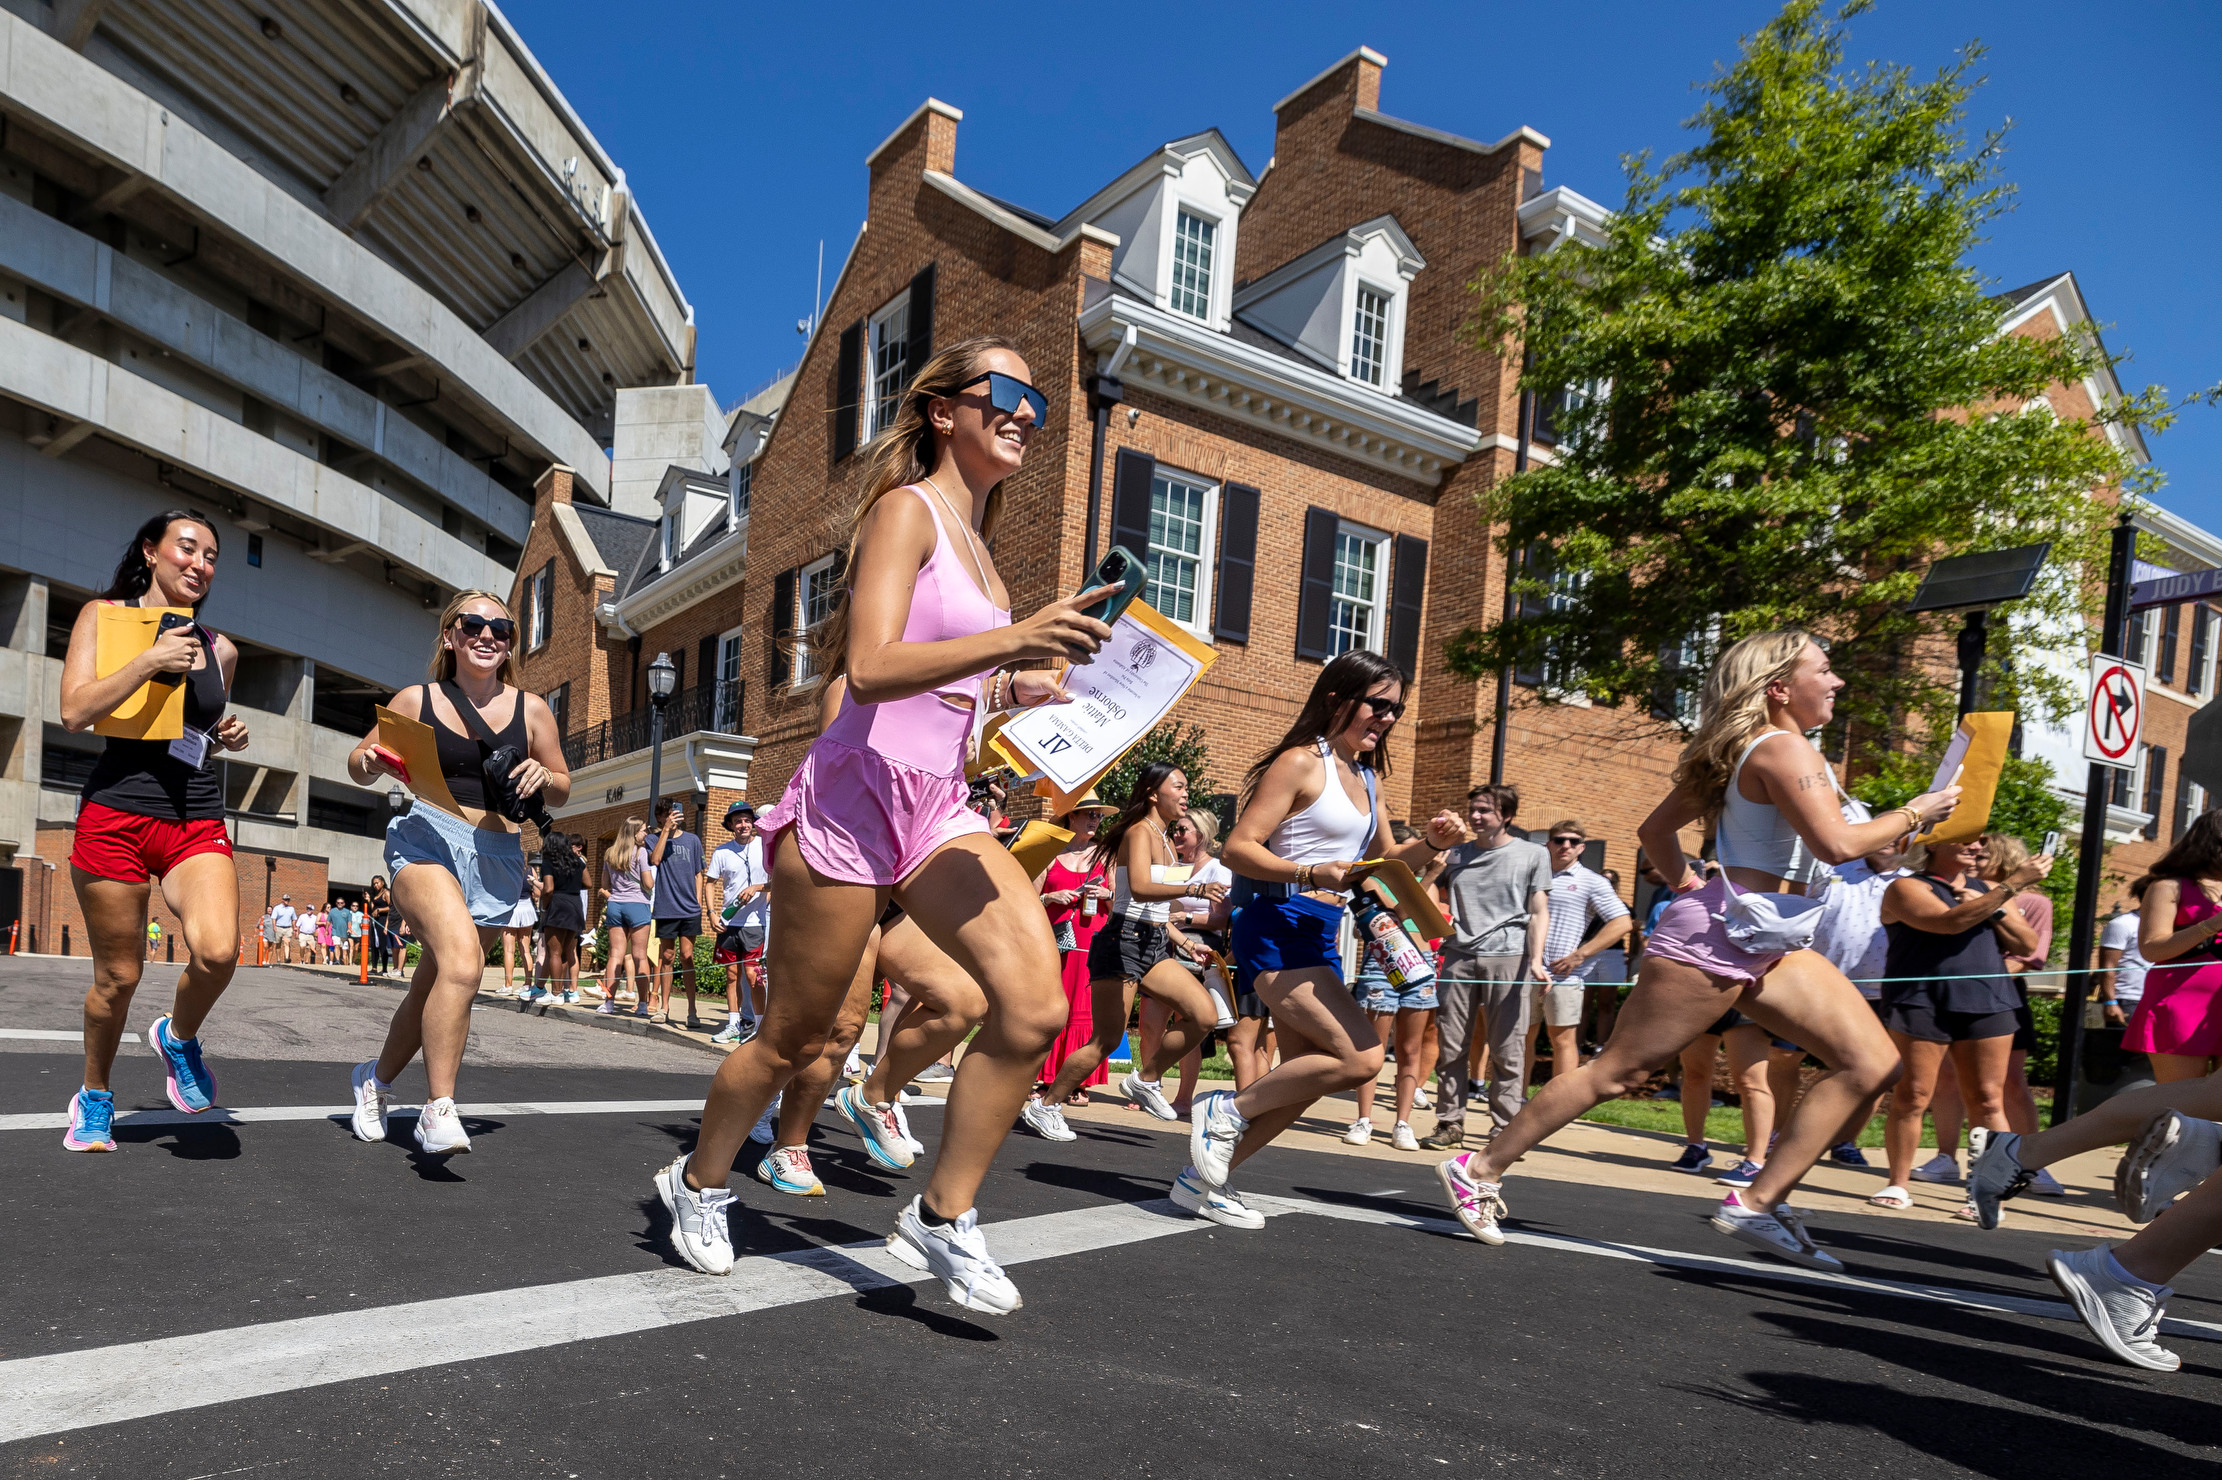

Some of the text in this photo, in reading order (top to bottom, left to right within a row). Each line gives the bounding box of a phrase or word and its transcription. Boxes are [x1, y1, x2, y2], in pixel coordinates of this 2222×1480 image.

[2151, 573, 2205, 599] JUDY
[1087, 685, 1126, 720] Osborne
[1048, 713, 1074, 737] GAMMA
[1071, 733, 1093, 754] DELTA
[772, 1159, 786, 1177] HOKA
